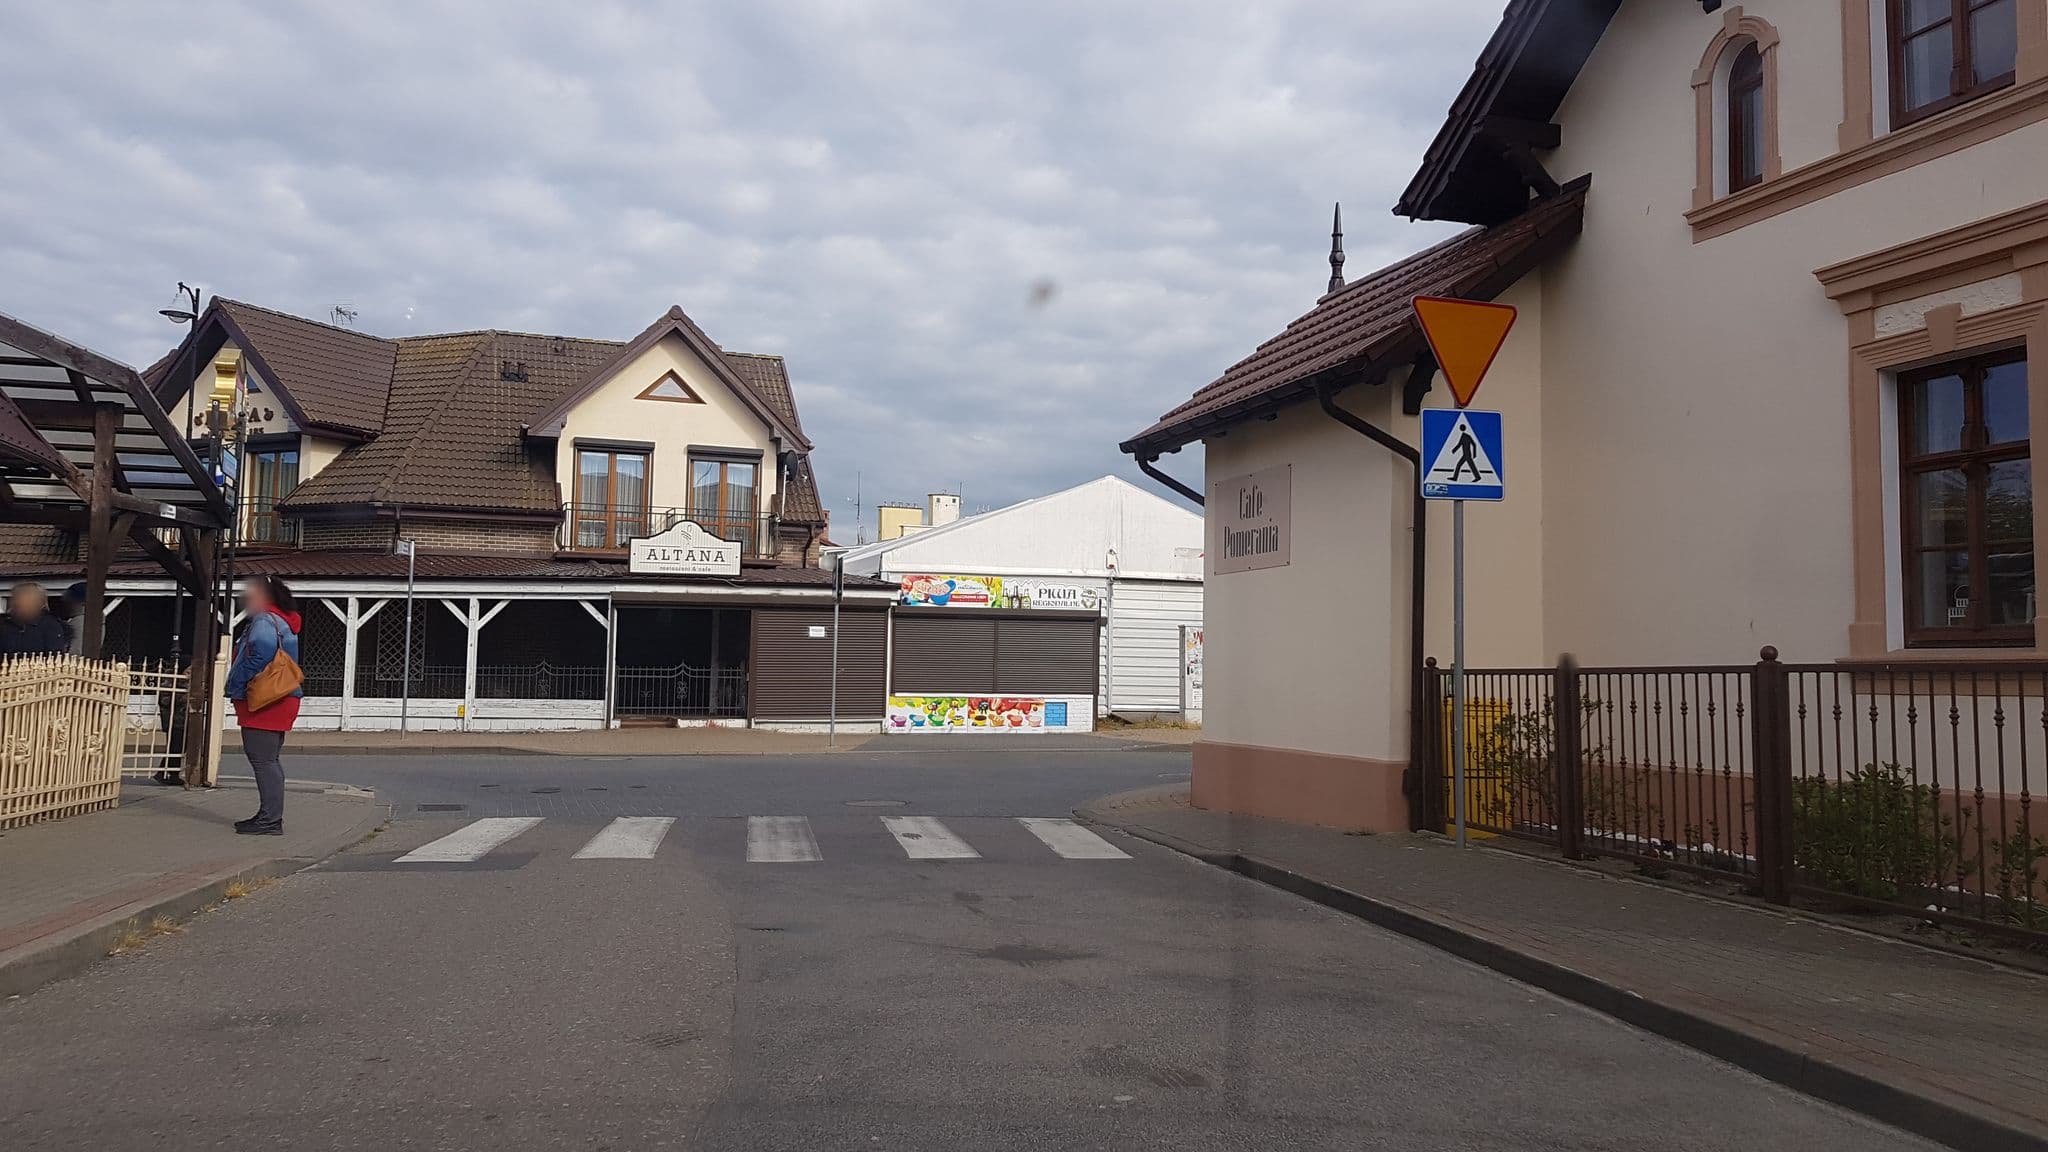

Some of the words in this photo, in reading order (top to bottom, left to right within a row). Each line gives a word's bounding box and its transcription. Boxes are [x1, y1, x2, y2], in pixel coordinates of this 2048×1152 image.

[1240, 485, 1263, 520] Cafe
[1223, 518, 1279, 560] Pomerania
[646, 548, 726, 562] ALTANA
[1039, 588, 1077, 600] PIWA
